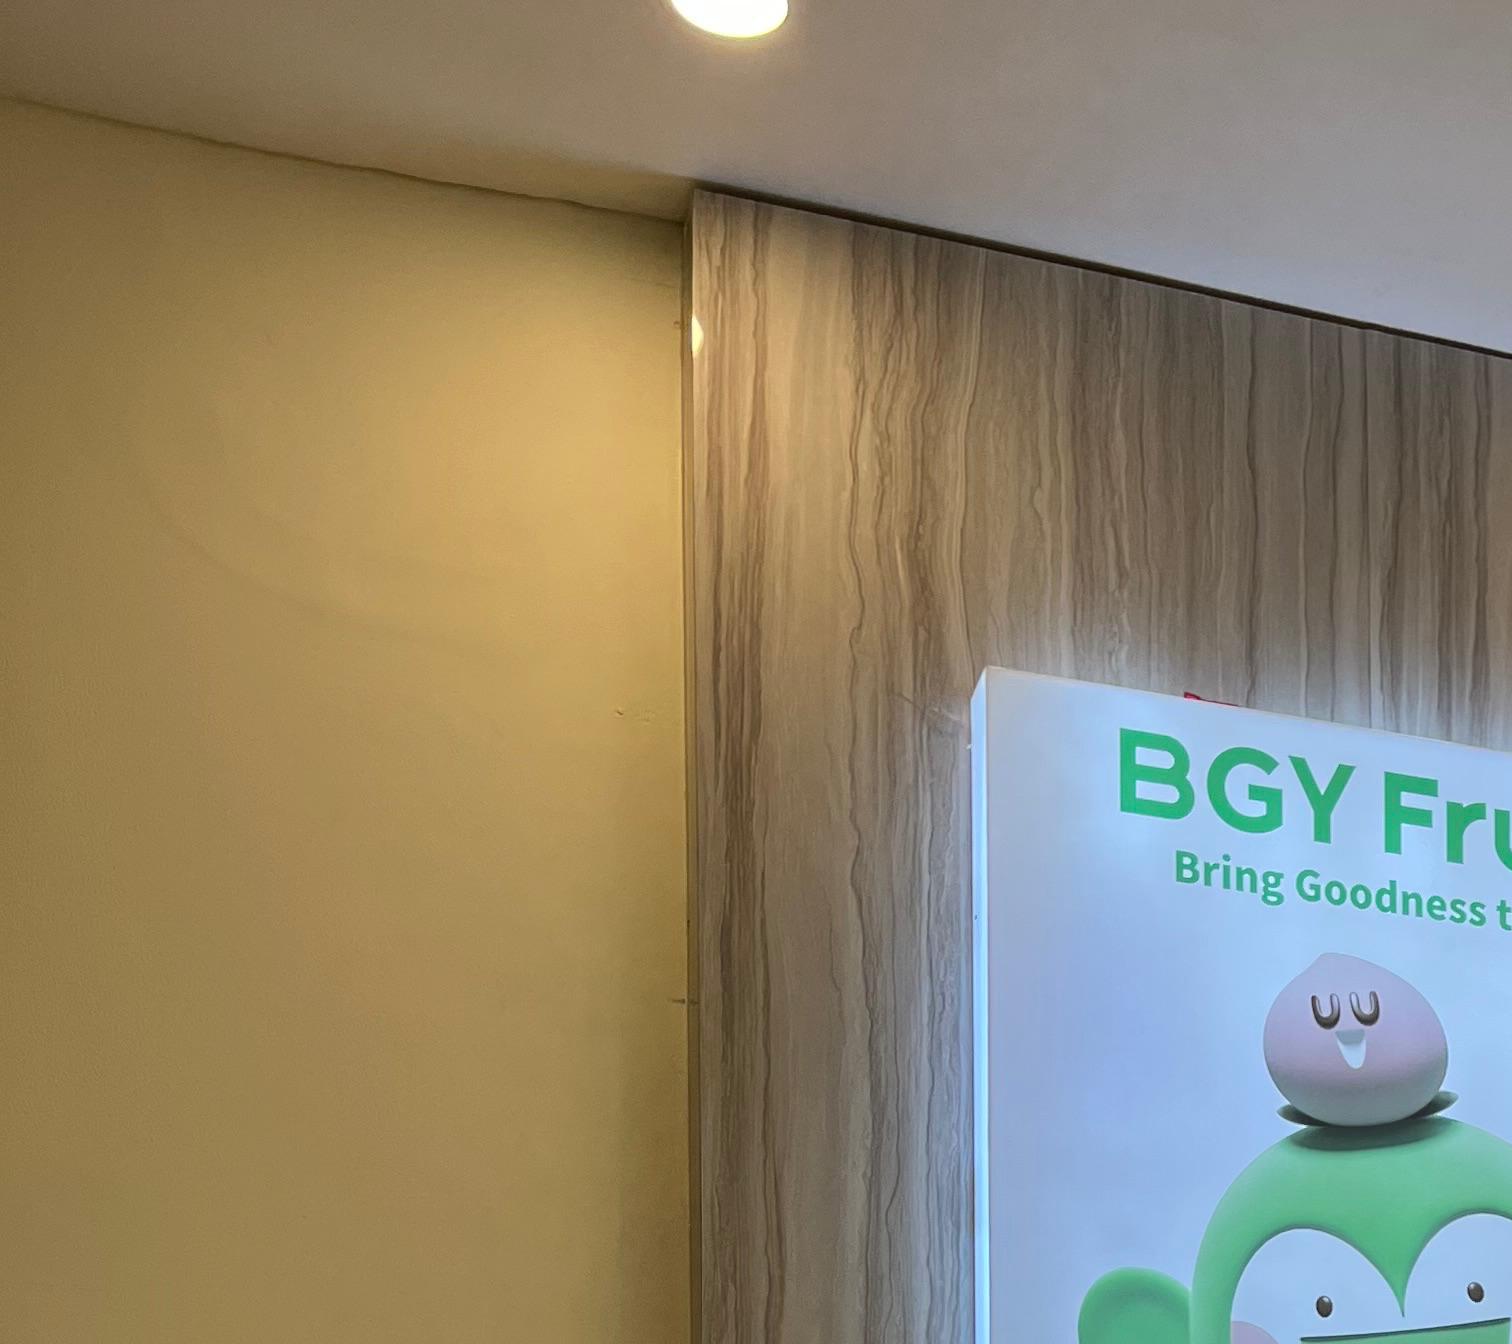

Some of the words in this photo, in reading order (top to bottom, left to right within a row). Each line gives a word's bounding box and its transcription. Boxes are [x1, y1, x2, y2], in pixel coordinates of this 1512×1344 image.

[1118, 727, 1356, 844] BGY
[1174, 850, 1285, 907] Bring
[1295, 868, 1487, 930] Goodness
